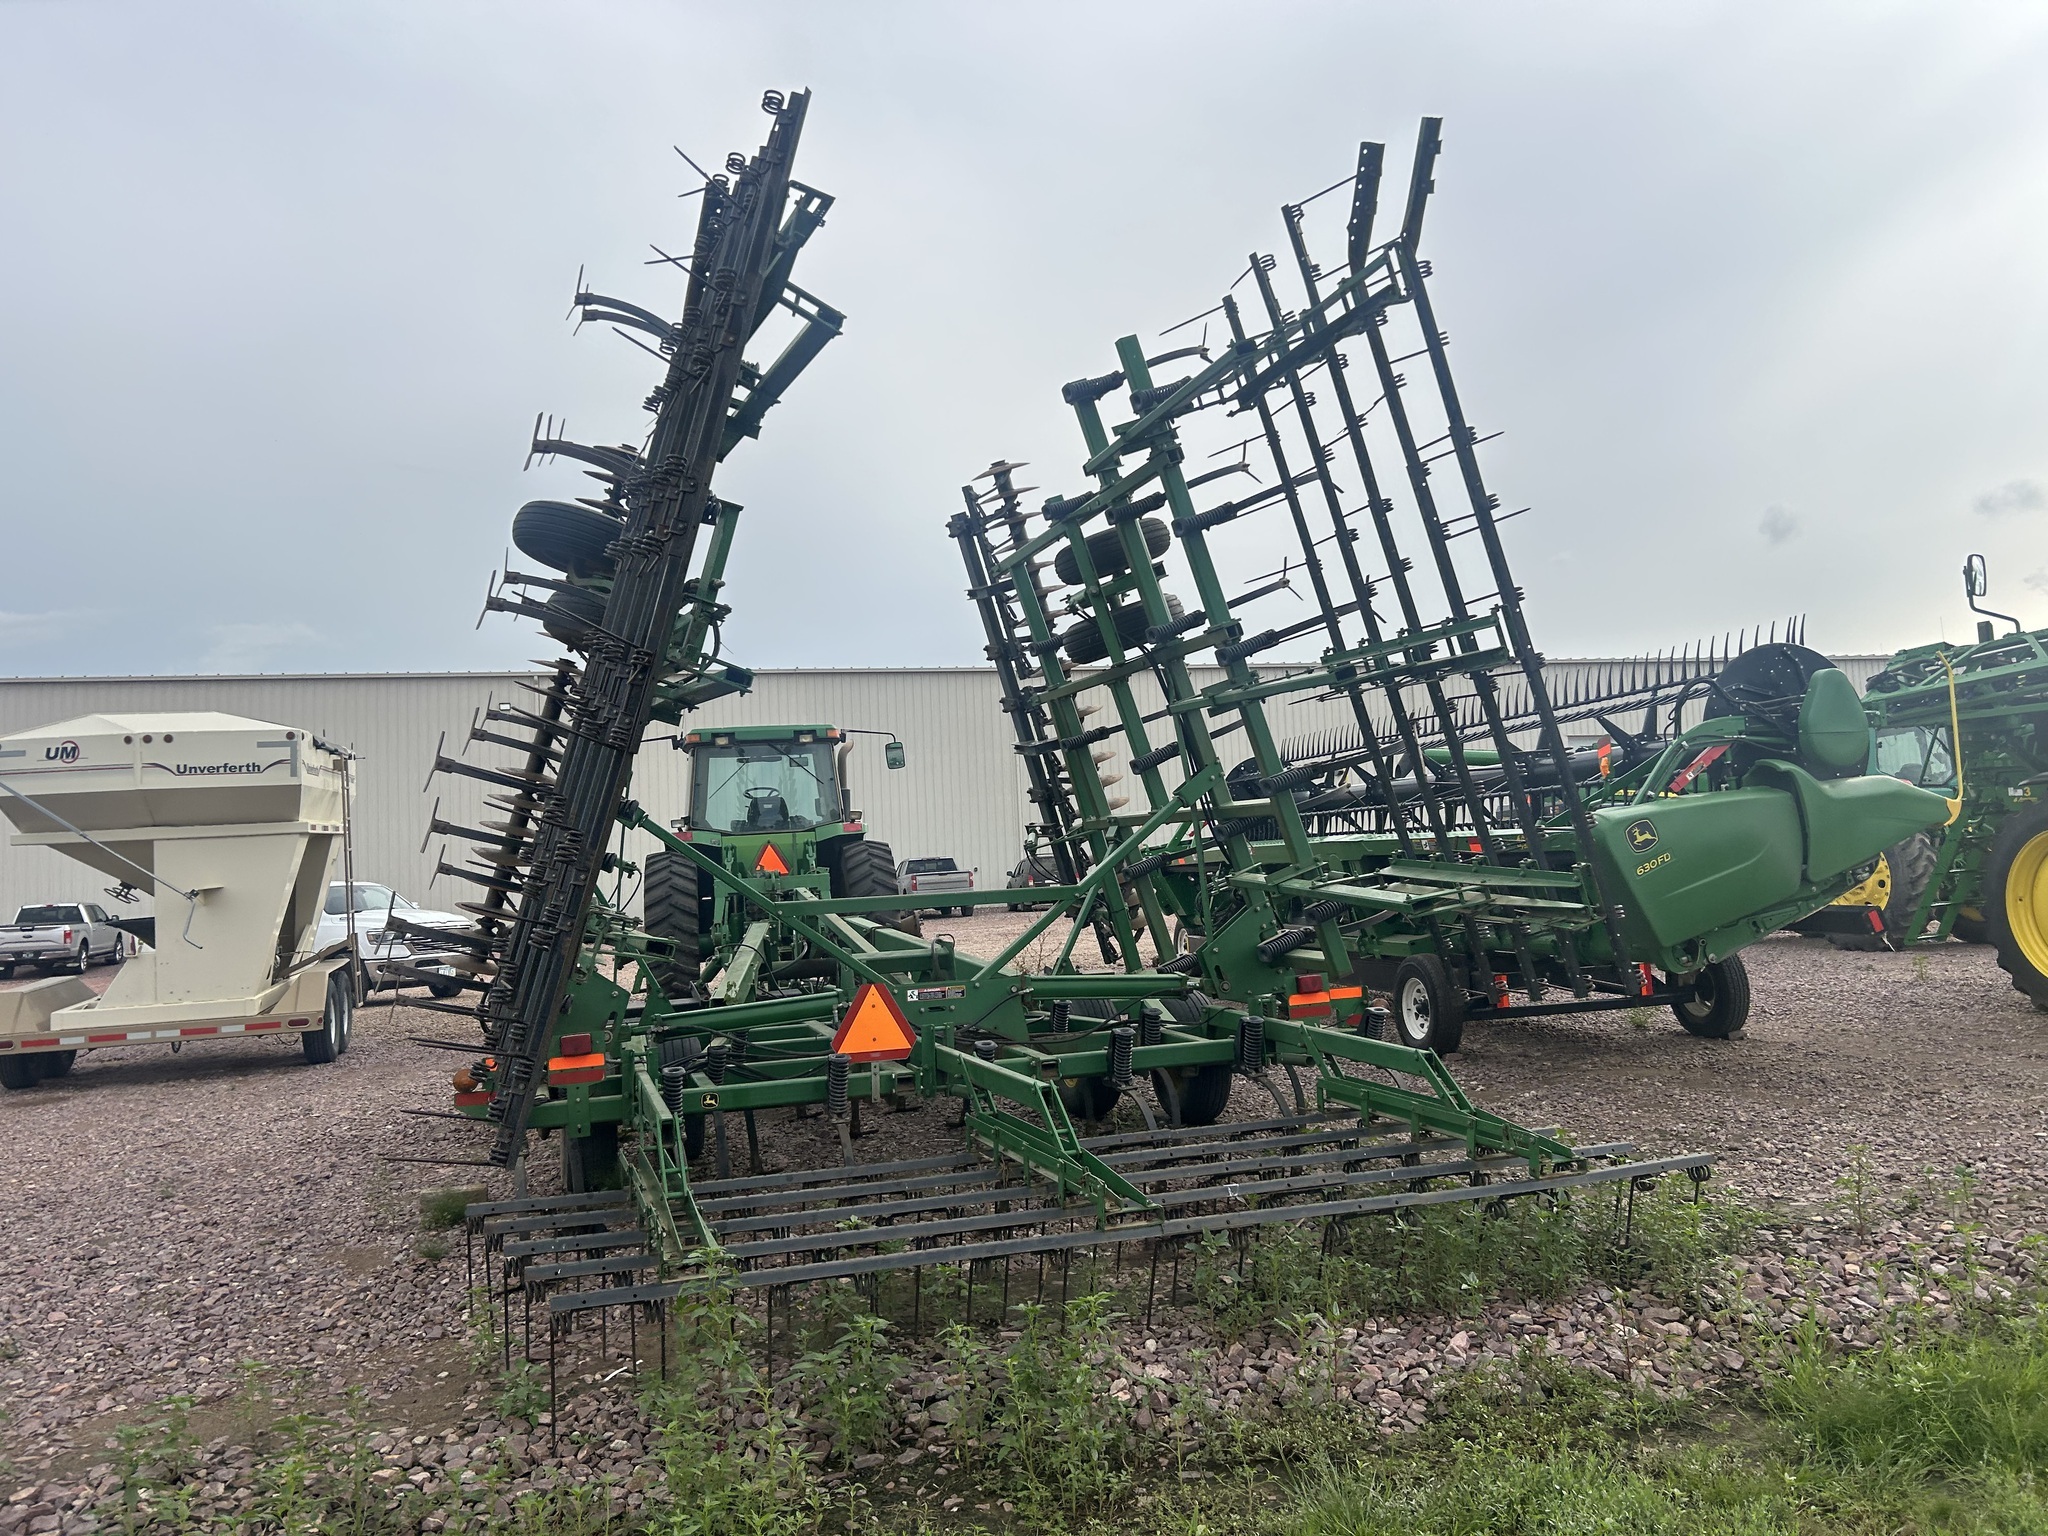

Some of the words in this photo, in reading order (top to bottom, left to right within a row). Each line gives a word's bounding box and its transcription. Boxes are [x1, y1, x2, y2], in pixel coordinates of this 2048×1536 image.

[45, 746, 78, 761] UM
[176, 762, 261, 774] Unverferth
[1636, 852, 1671, 876] 630FD
